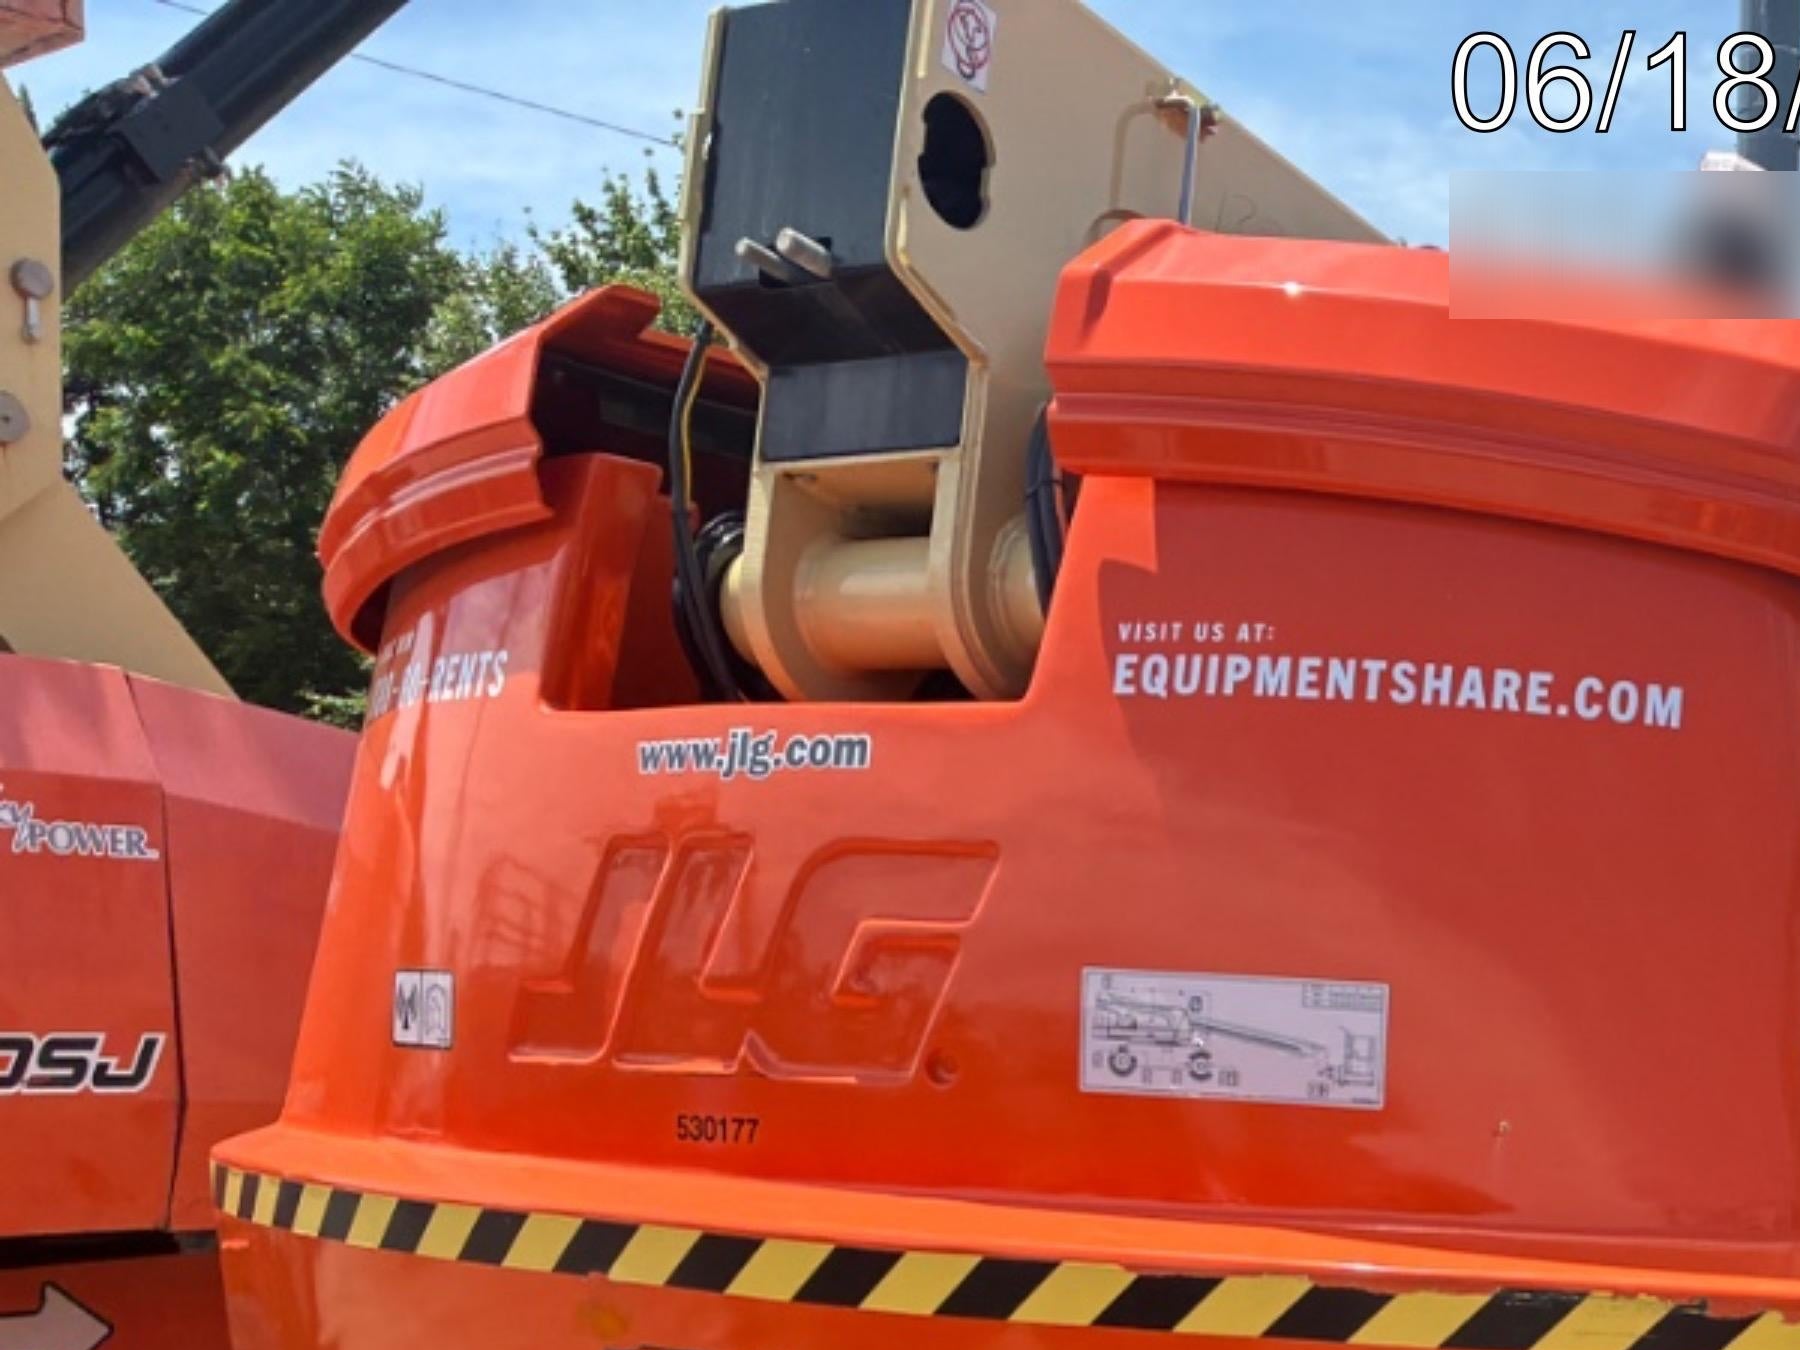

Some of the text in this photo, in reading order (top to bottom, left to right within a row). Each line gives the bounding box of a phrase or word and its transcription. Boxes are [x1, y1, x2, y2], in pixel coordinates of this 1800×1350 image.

[1118, 622, 1276, 643] VISIT US AT:
[1112, 653, 1683, 729] EQUIPMENTSHARE.COM
[640, 730, 870, 779] www.jlg.com
[507, 832, 1000, 1087] JLG
[677, 1114, 760, 1144] 530177
